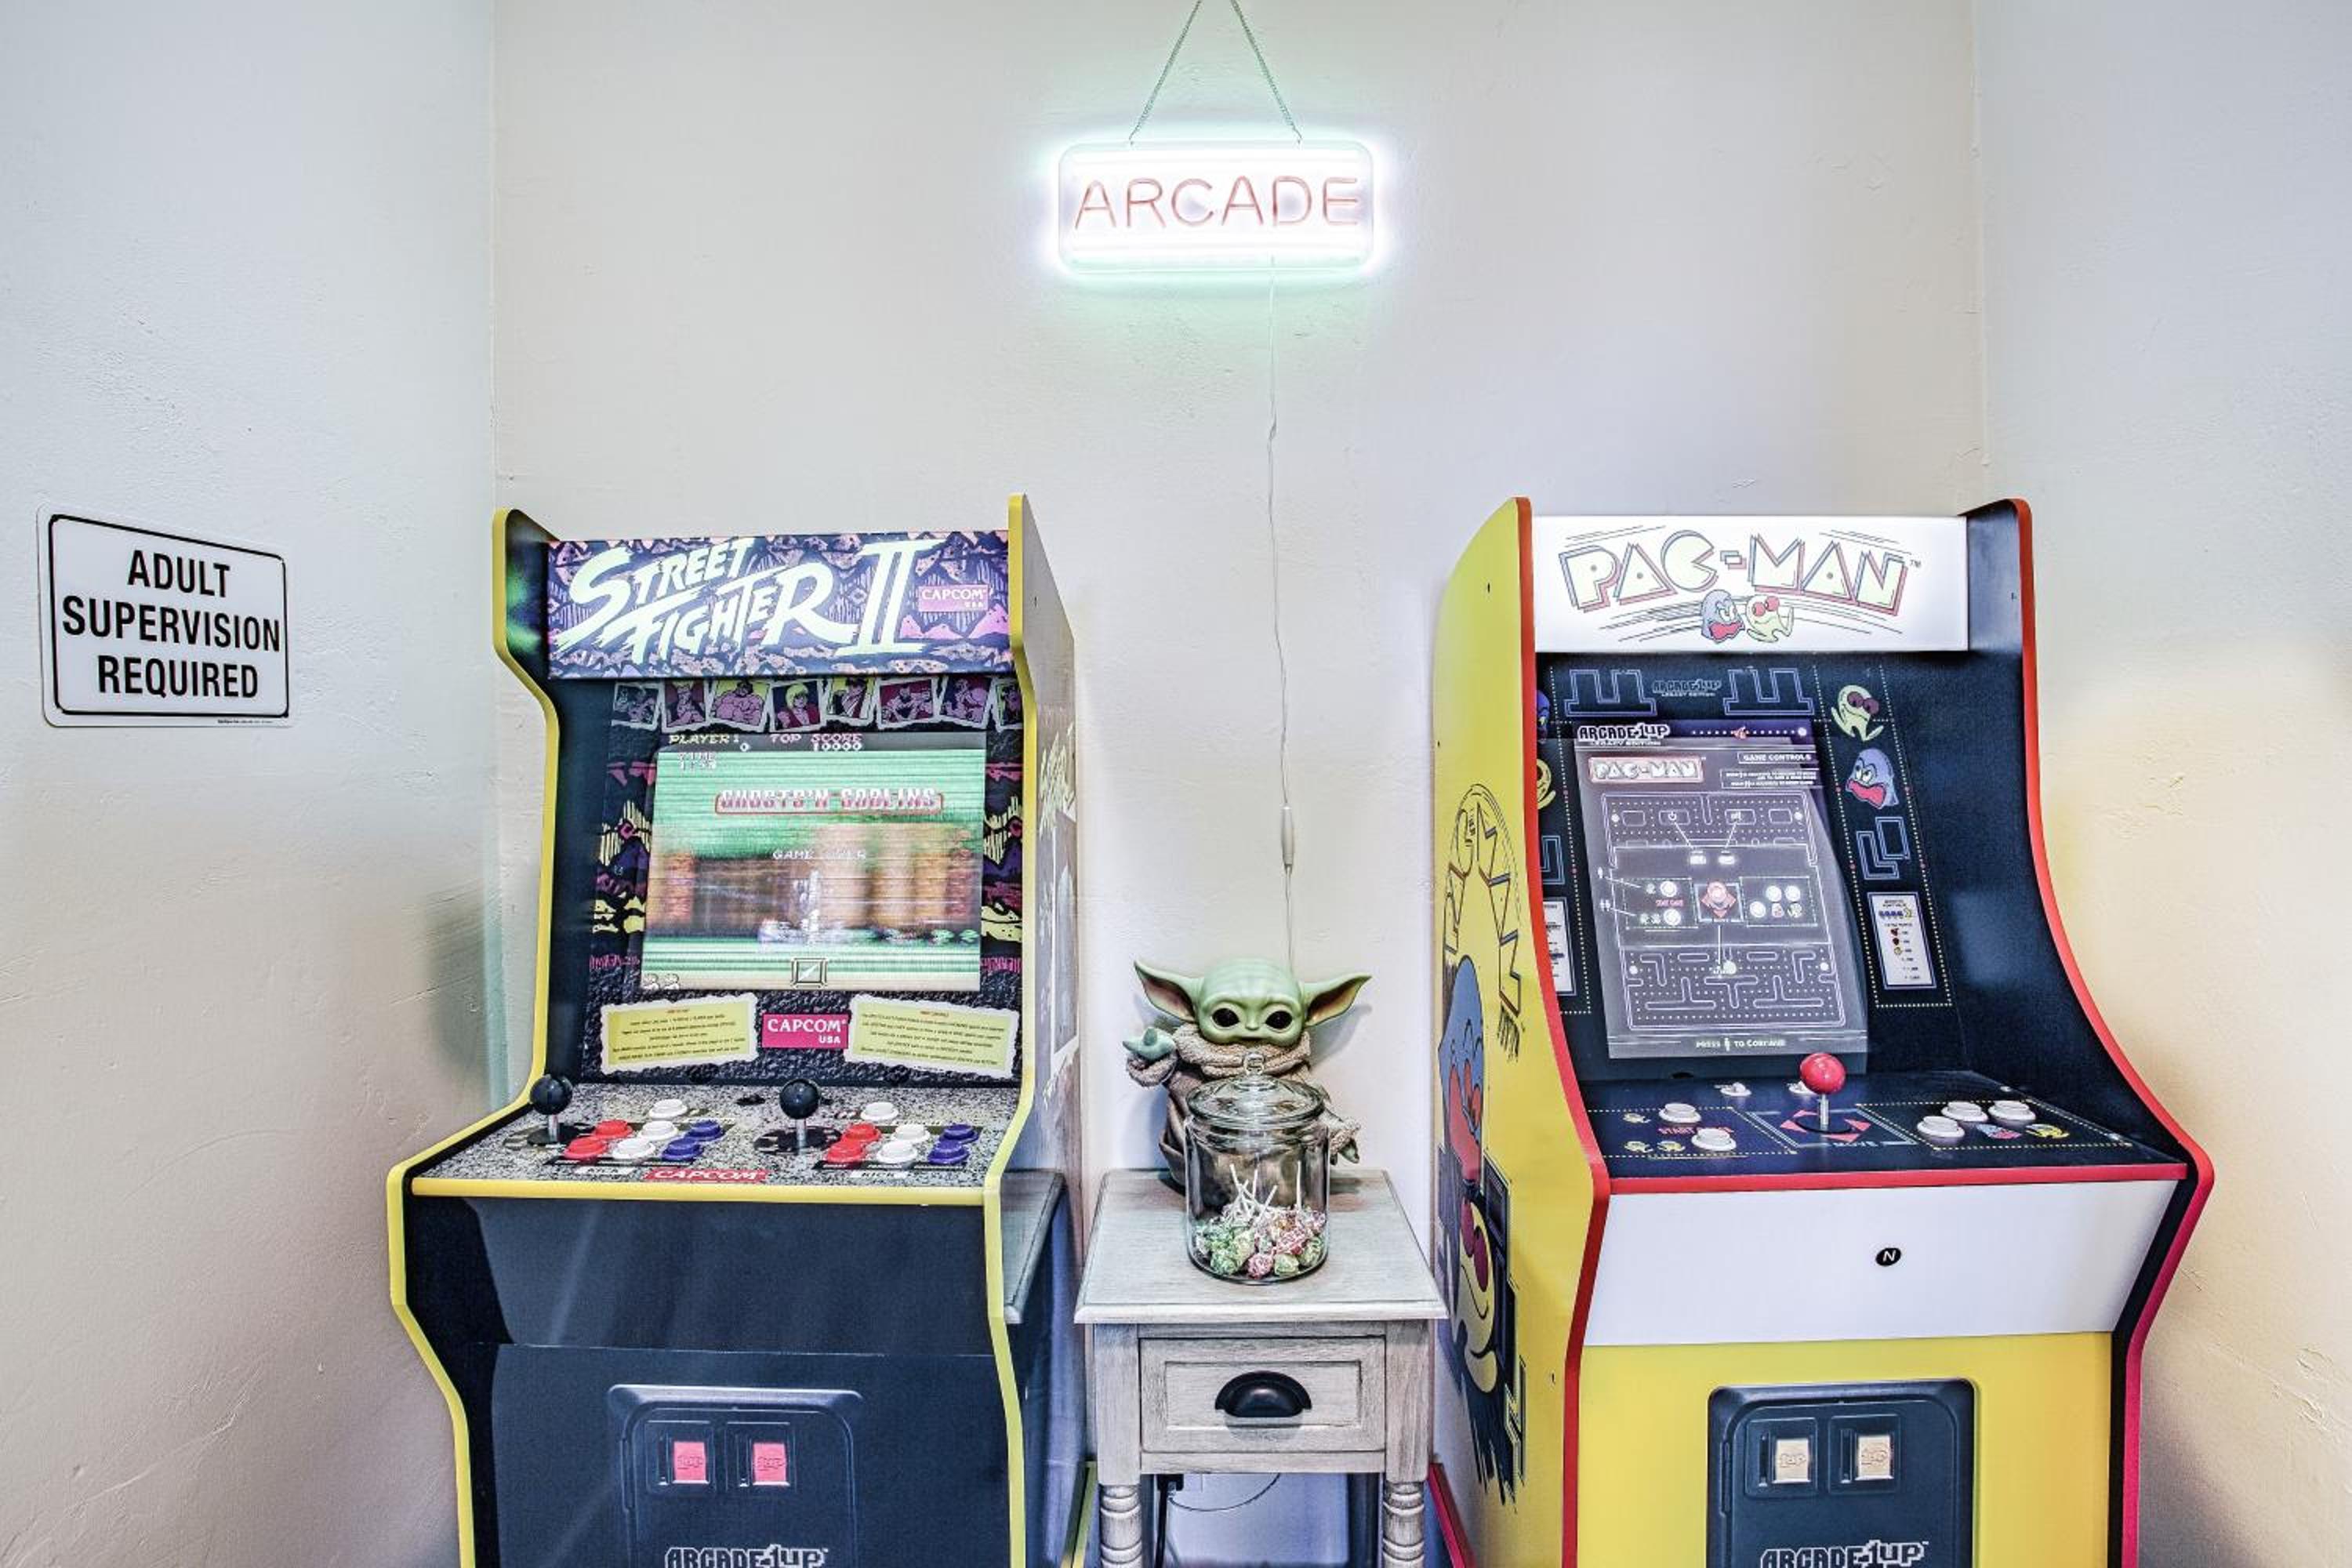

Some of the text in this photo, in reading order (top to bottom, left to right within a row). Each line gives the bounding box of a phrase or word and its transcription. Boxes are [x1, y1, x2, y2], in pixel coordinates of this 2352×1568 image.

[1074, 175, 1359, 230] ARCADE
[127, 550, 230, 597] ADULT
[551, 537, 760, 652] STREET
[921, 588, 983, 601] CAPCOM
[1558, 529, 1909, 616] PAC-MAN
[593, 538, 946, 664] FIGHTER II
[62, 595, 281, 652] SUPERVISION
[97, 655, 259, 699] REQUIRED
[669, 734, 730, 745] PLAYER
[770, 734, 802, 744] TOP
[811, 733, 862, 744] SCORE
[768, 1018, 841, 1033] CAPCOM
[818, 1035, 841, 1044] USA
[655, 1169, 759, 1180] CAPCOM
[1882, 1250, 1896, 1262] N
